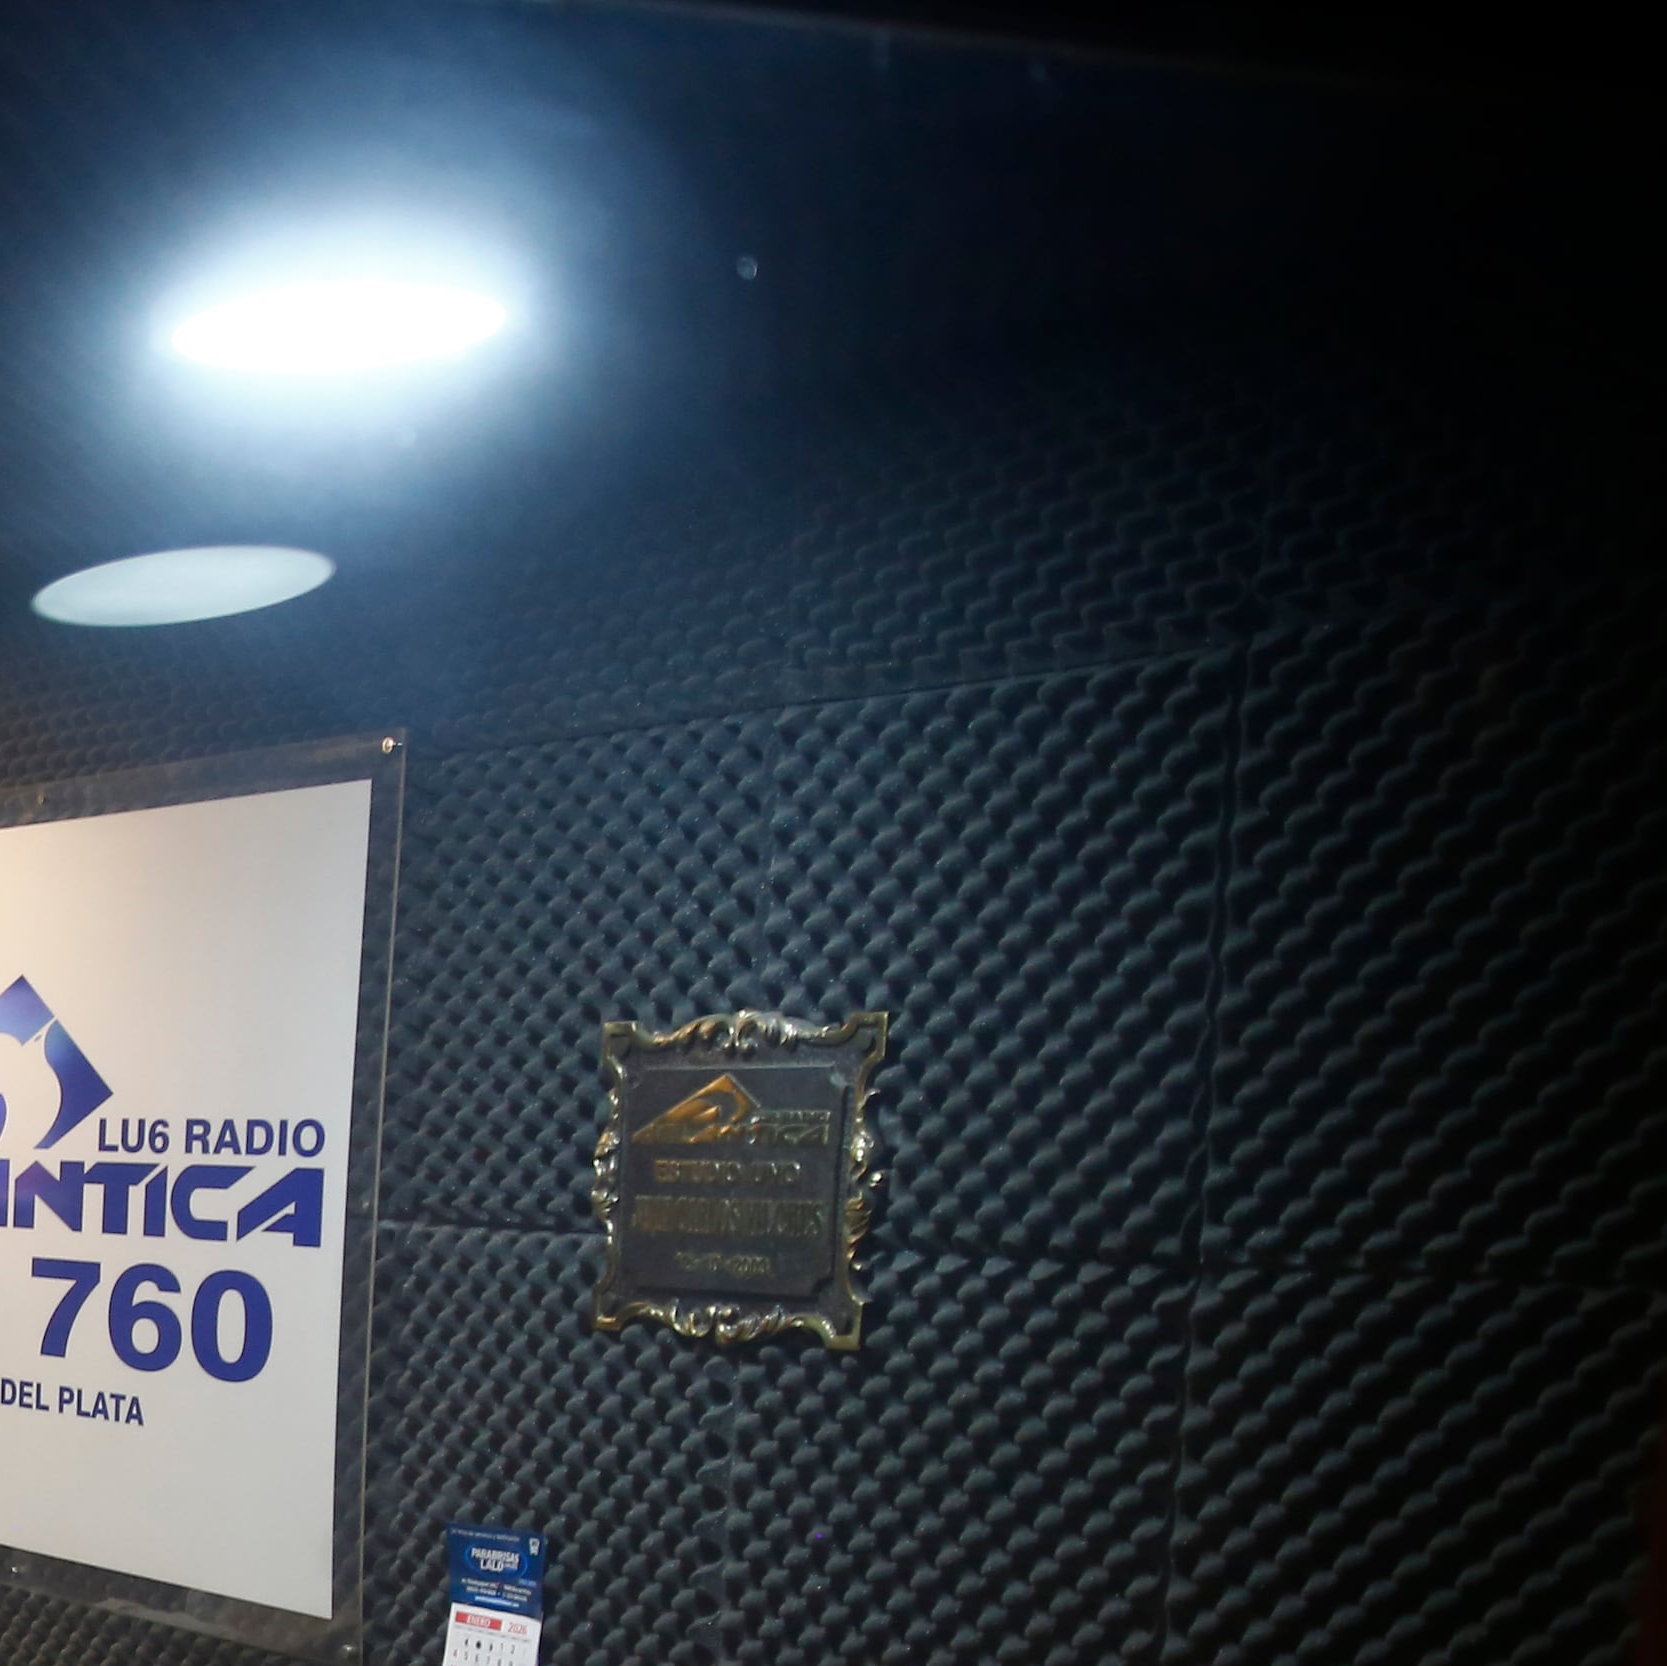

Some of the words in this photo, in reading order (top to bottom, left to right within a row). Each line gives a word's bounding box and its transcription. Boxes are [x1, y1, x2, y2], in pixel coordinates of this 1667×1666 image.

[97, 1118, 170, 1154] LU6
[184, 1118, 326, 1157] RADIO
[31, 1257, 273, 1383] 760
[1, 1378, 50, 1413] DEL
[58, 1385, 145, 1426] PLATA
[466, 1614, 491, 1627] ENERO
